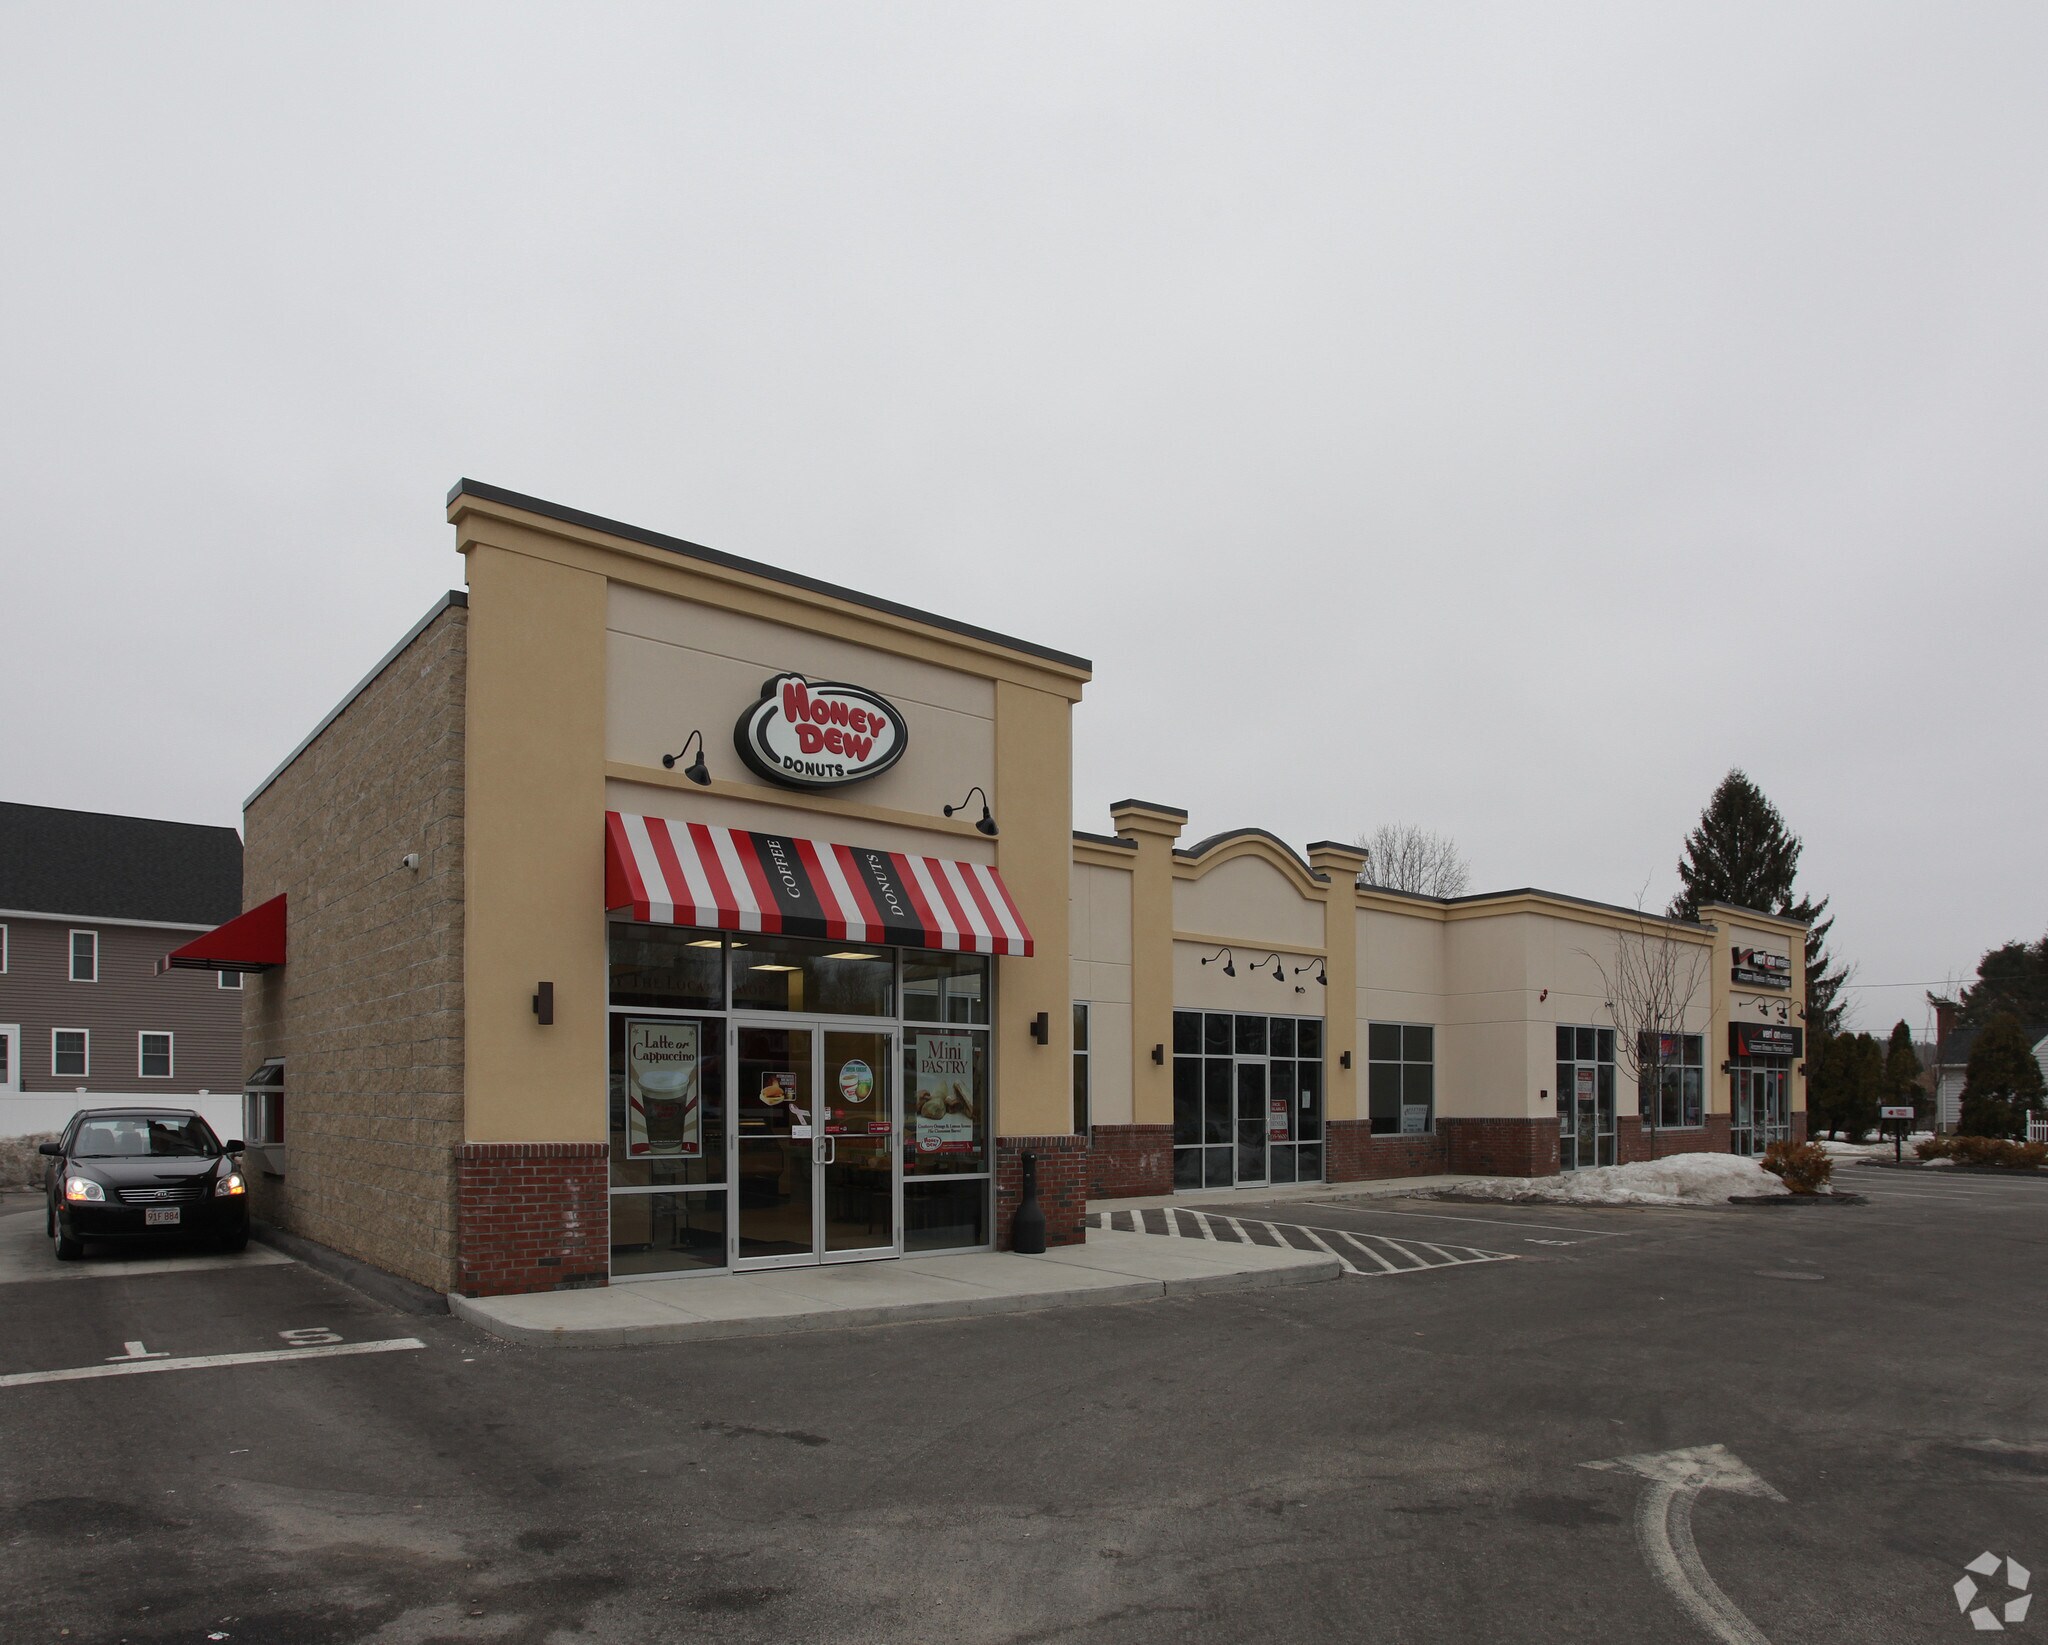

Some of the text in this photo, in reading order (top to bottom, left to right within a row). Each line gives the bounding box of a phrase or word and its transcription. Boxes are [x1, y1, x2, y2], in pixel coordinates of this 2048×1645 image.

[783, 683, 886, 738] HONEY
[795, 723, 872, 762] DEW
[783, 756, 845, 777] DONUTS
[767, 839, 801, 898] COFFEE
[866, 853, 905, 917] DONUTS
[645, 1030, 689, 1049] Latte or
[928, 1040, 961, 1060] Mini
[633, 1042, 695, 1064] Cappuccino
[922, 1060, 968, 1075] PASTRY
[148, 1211, 178, 1222] 91F 884
